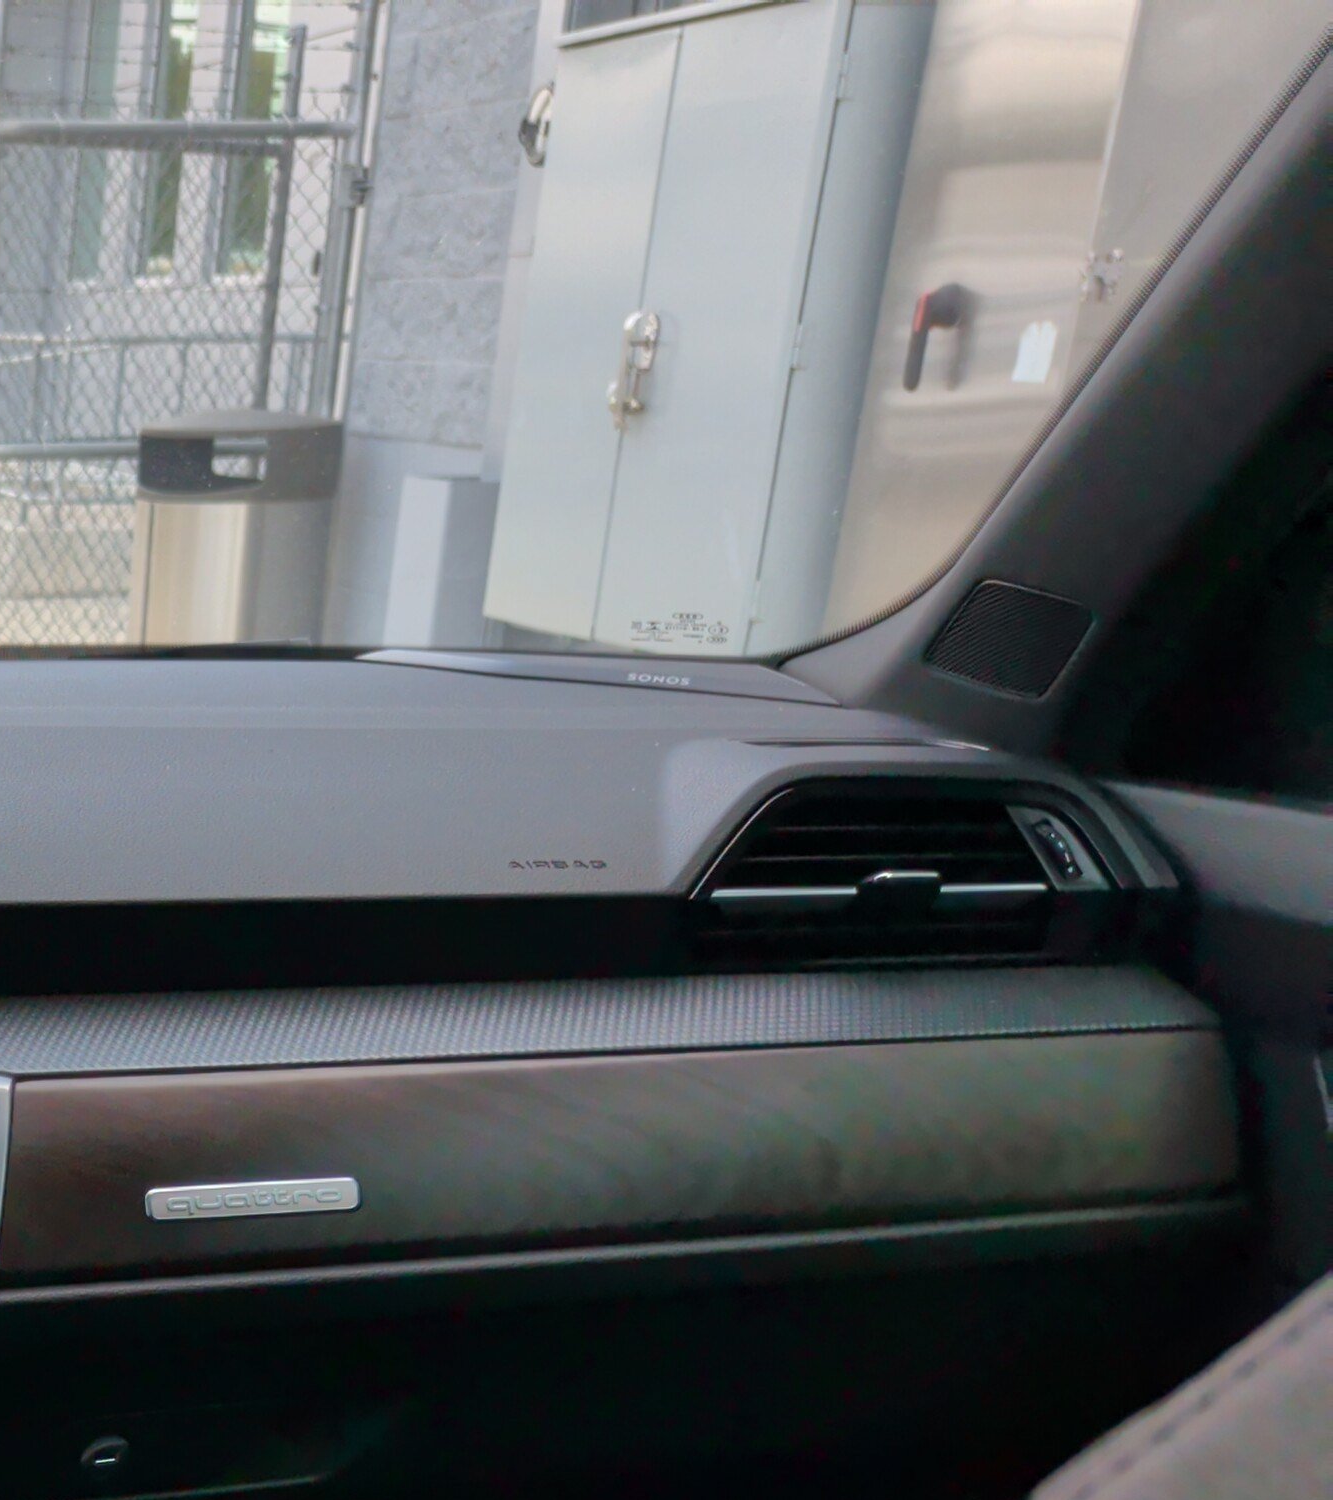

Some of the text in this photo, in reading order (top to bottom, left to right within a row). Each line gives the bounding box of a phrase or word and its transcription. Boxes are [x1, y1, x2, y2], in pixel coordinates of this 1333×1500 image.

[627, 672, 691, 686] SONOS
[508, 859, 608, 870] AIRBAG
[166, 1188, 342, 1216] quattro
